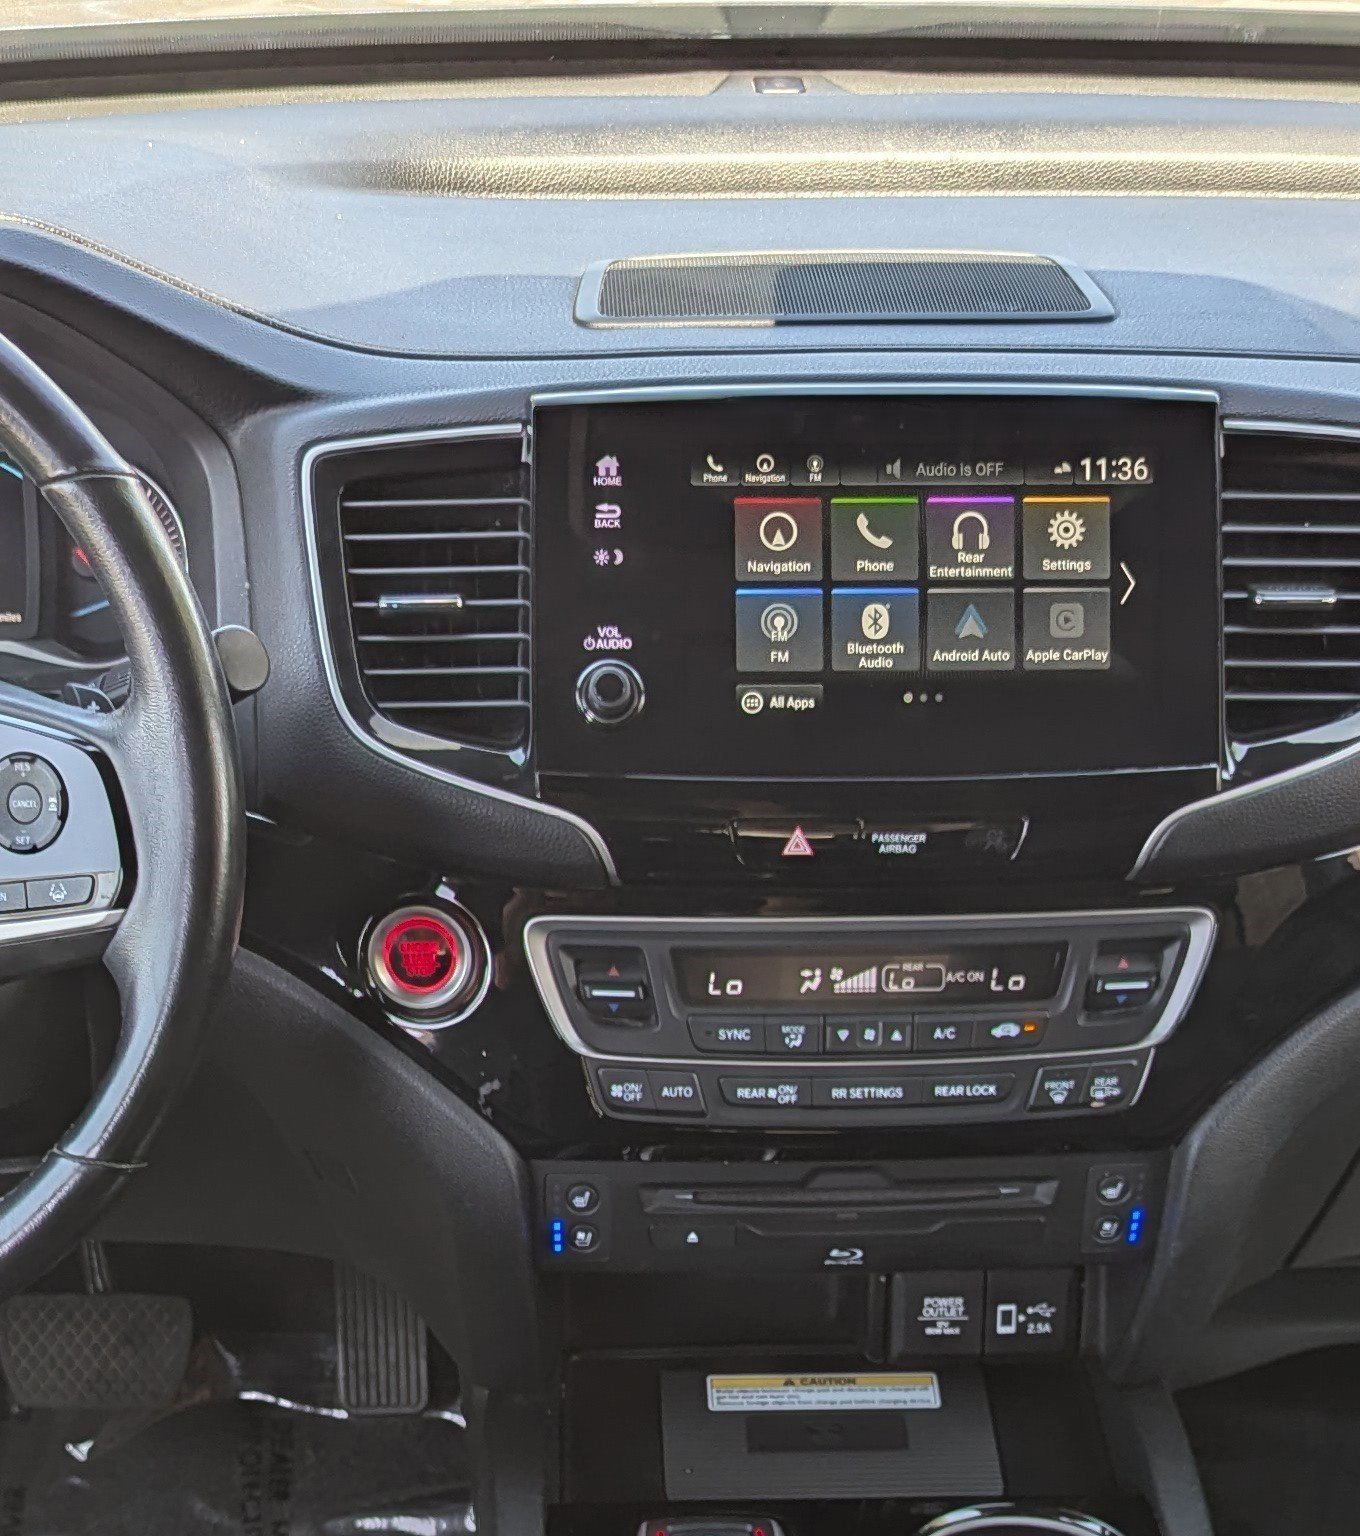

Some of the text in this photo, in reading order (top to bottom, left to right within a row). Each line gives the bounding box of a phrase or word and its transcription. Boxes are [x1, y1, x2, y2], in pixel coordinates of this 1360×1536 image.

[915, 462, 957, 477] Audio
[975, 462, 1004, 476] OFF
[1080, 457, 1148, 481] 11:36
[593, 477, 622, 486] HOME
[703, 474, 728, 483] Phone
[745, 474, 785, 484] Navigation
[809, 474, 821, 482] FM
[594, 519, 621, 529] BACK
[957, 551, 985, 564] Rear
[747, 560, 811, 575] Navigation
[855, 559, 894, 572] Phone
[929, 565, 1012, 578] Entertainment
[1042, 558, 1091, 574] Settings
[597, 626, 622, 638] VOL
[596, 637, 632, 650] AUDIO
[847, 642, 904, 655] Bluetooth
[770, 651, 789, 663] FM
[933, 649, 1010, 662] Android Auto
[1026, 648, 1108, 664] Apple CarPlay
[858, 656, 893, 668] Audio
[770, 696, 815, 712] All Apps
[14, 762, 30, 771] RES
[12, 799, 38, 808] CANCEL
[15, 836, 30, 844] SET
[872, 833, 926, 843] PASSENGER
[878, 844, 917, 854] AIRBAG
[947, 970, 984, 984] A/C ON
[990, 968, 1026, 991] Lo
[708, 971, 743, 996] Lo
[719, 1028, 751, 1041] SYNC
[781, 1025, 806, 1034] MODE
[934, 1027, 957, 1040] A/C
[1044, 1080, 1076, 1090] FRONT
[1094, 1076, 1119, 1086] REAR
[623, 1083, 643, 1092] ON/
[662, 1086, 693, 1098] AUTO
[737, 1087, 765, 1099] REAR
[778, 1084, 798, 1094] ON/
[832, 1087, 903, 1099] RR SETTINGS
[934, 1085, 998, 1097] REAR LOCK
[623, 1092, 642, 1102] OFF
[778, 1094, 797, 1104] OFF
[923, 1296, 965, 1308] POWER
[922, 1307, 965, 1317] OUTLET
[1026, 1322, 1052, 1334] 2.5A
[800, 1377, 856, 1386] CAUTION
